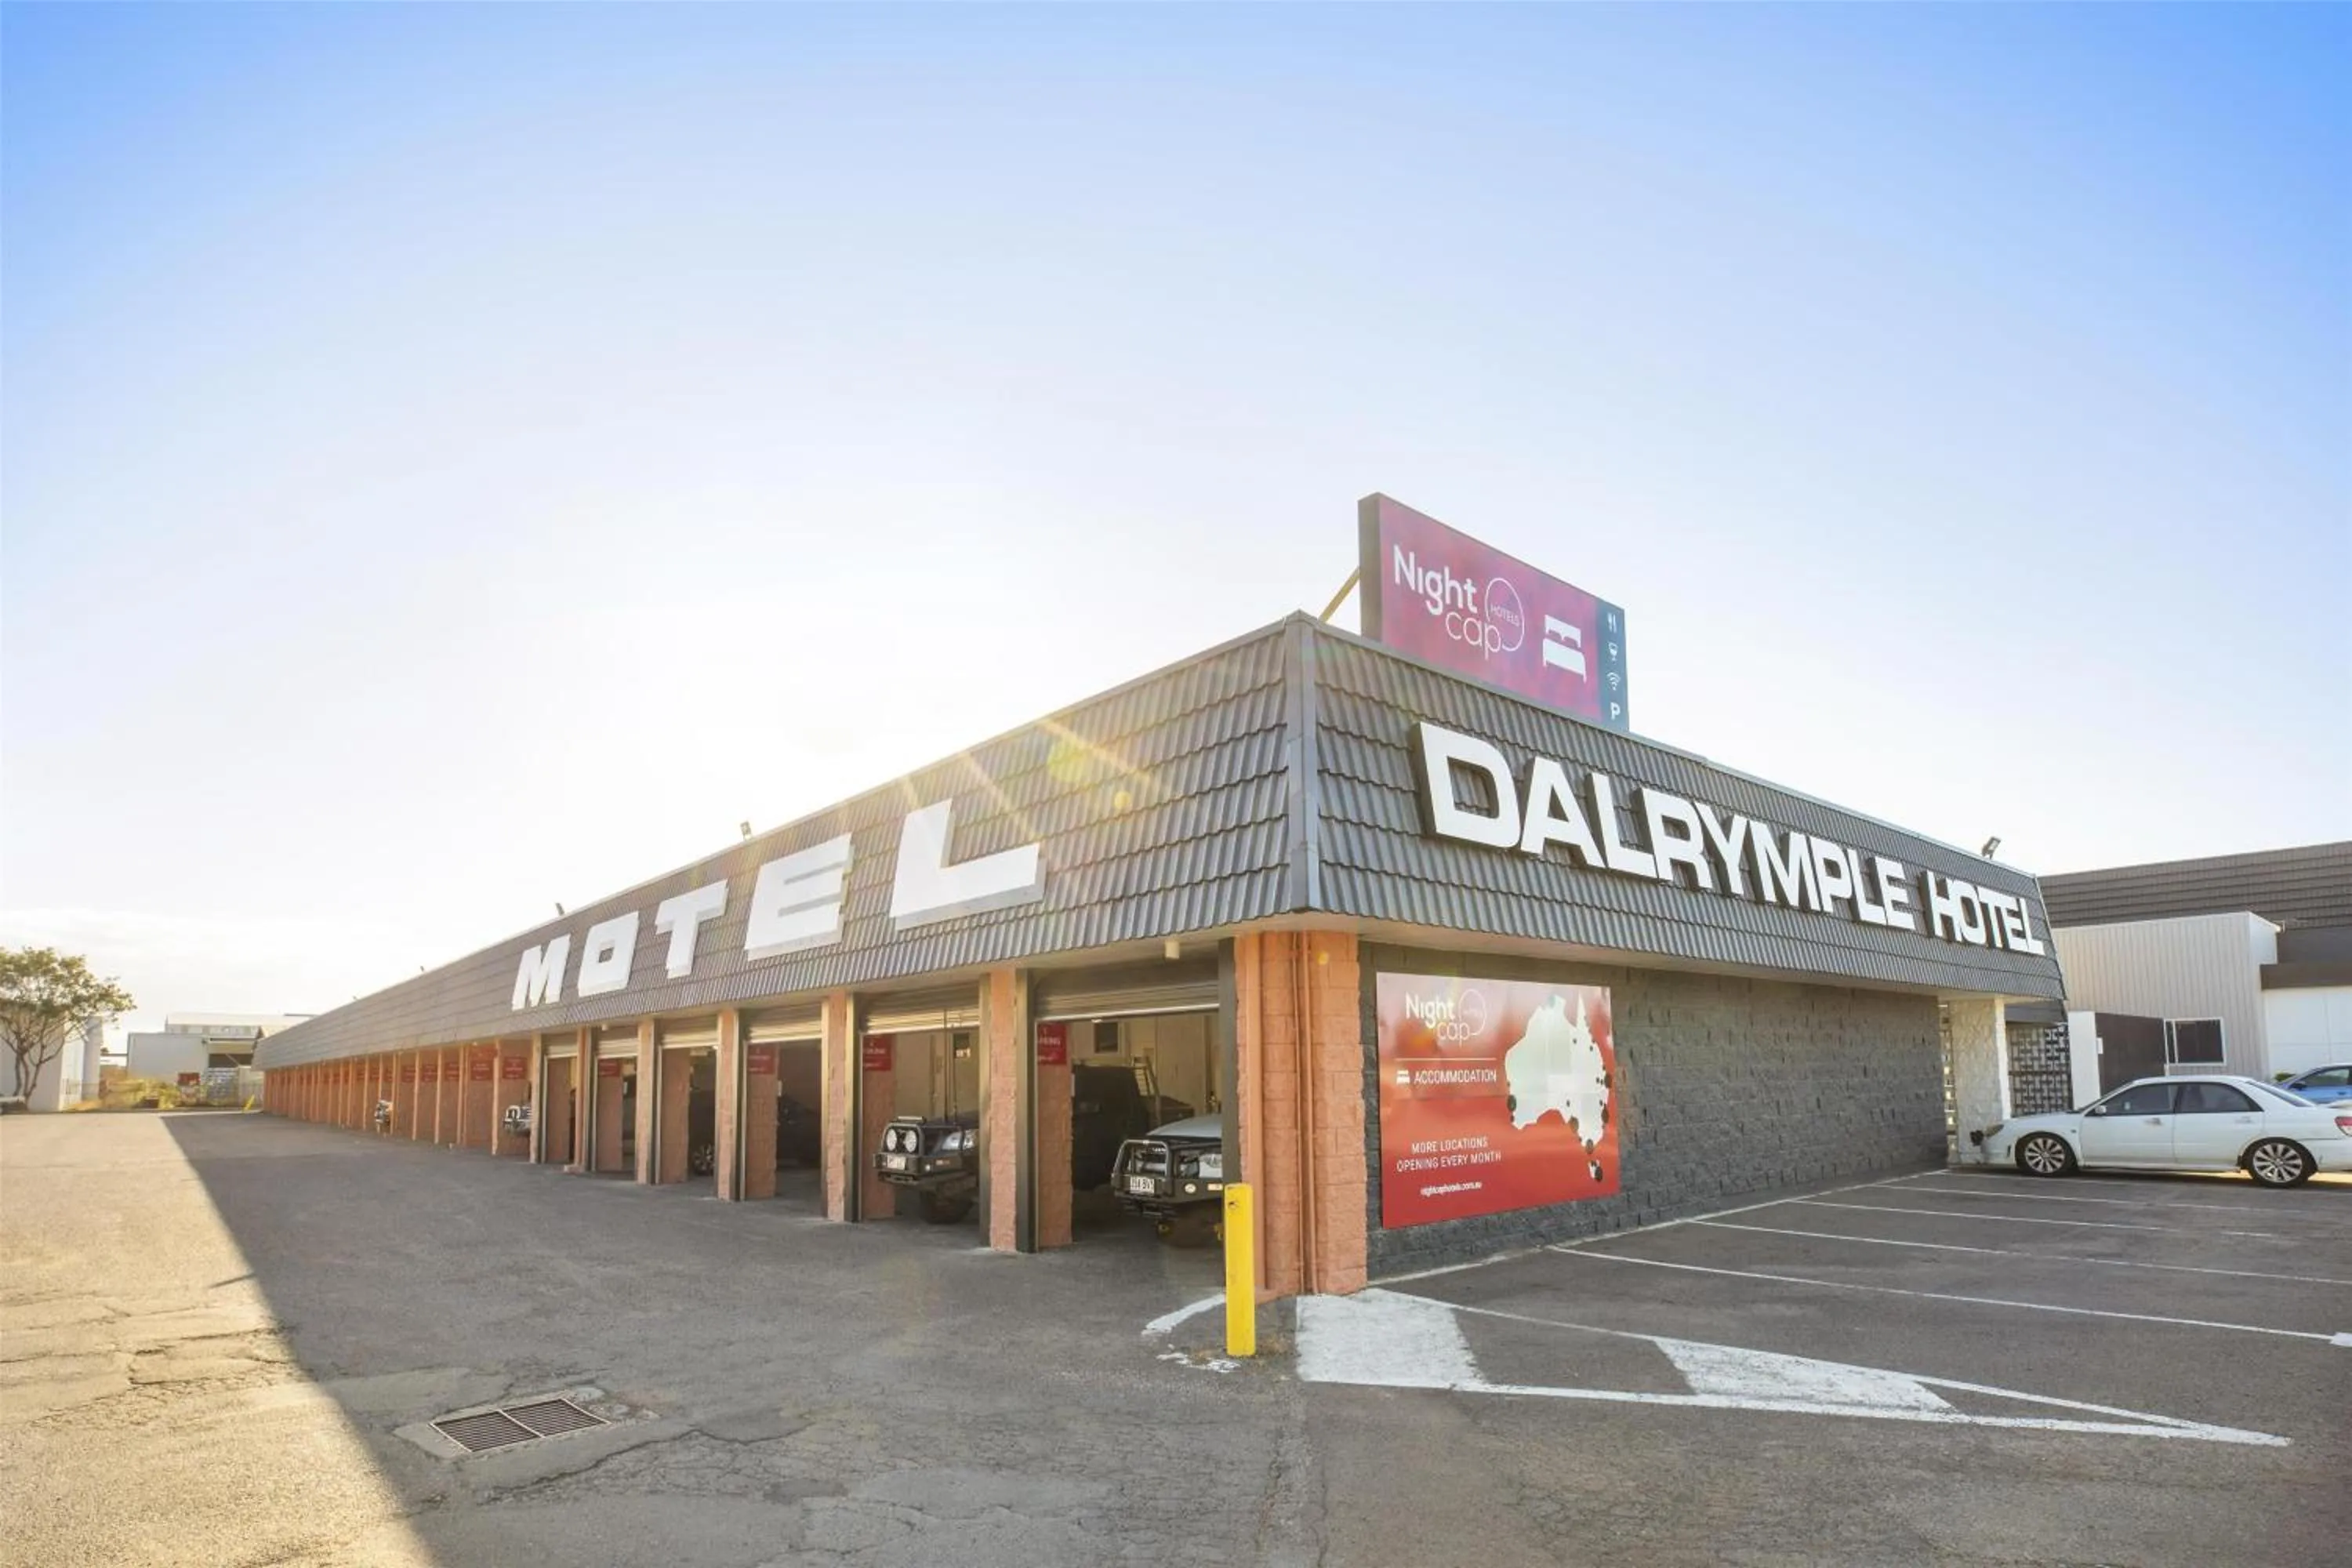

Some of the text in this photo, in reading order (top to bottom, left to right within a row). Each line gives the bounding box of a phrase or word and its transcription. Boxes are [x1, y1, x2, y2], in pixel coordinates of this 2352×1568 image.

[1393, 543, 1477, 615] Night
[1490, 603, 1520, 627] HOTELS
[1446, 612, 1501, 661] cap
[1610, 702, 1621, 720] P
[1417, 721, 2045, 956] DALRYMPLE HOTEL
[512, 797, 1042, 1012] MOTEL
[1405, 992, 1455, 1029] Night
[1436, 1021, 1470, 1048] cap
[1414, 1069, 1497, 1084] ACCOMMODATION
[1412, 1136, 1488, 1154] MORE LOCATIONS
[1396, 1150, 1501, 1172] OPENING EVERY MONTH
